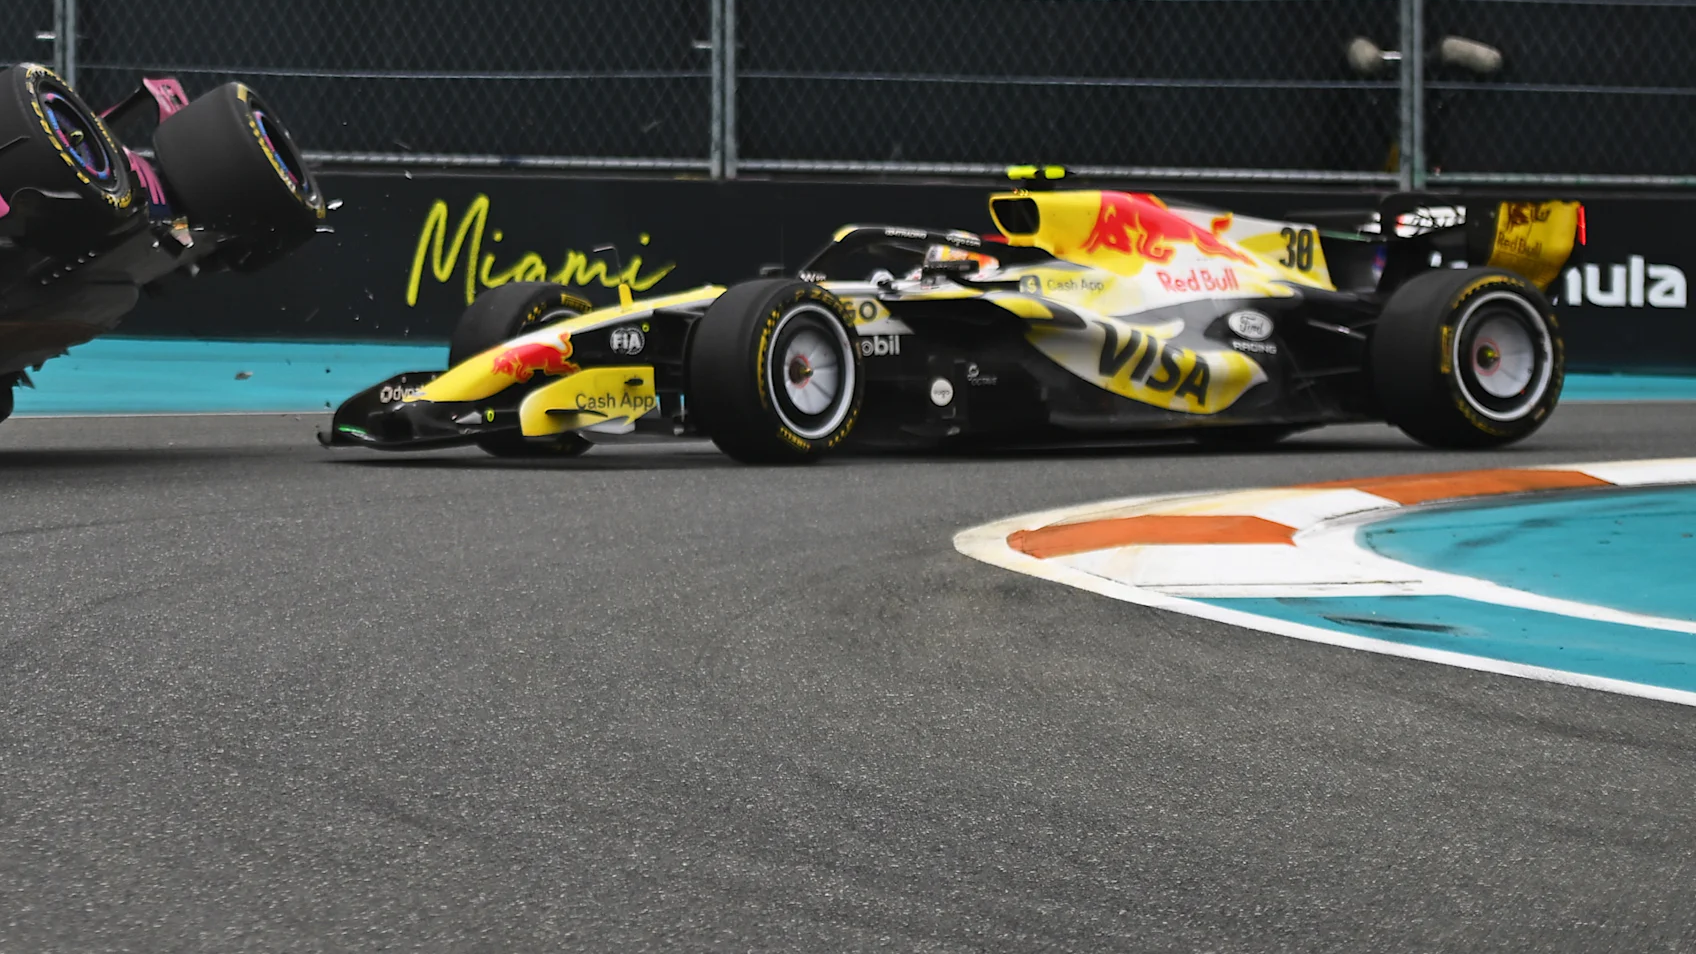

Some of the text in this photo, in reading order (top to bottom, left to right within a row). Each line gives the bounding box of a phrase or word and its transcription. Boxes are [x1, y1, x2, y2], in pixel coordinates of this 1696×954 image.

[406, 193, 677, 307] Miami
[1278, 227, 1313, 271] 30
[1047, 278, 1105, 293] Cash App
[1157, 269, 1240, 293] Red Bull
[611, 332, 642, 351] FIA
[1232, 340, 1278, 356] RACING
[1091, 320, 1211, 409] VISA
[575, 392, 655, 413] Cash App
